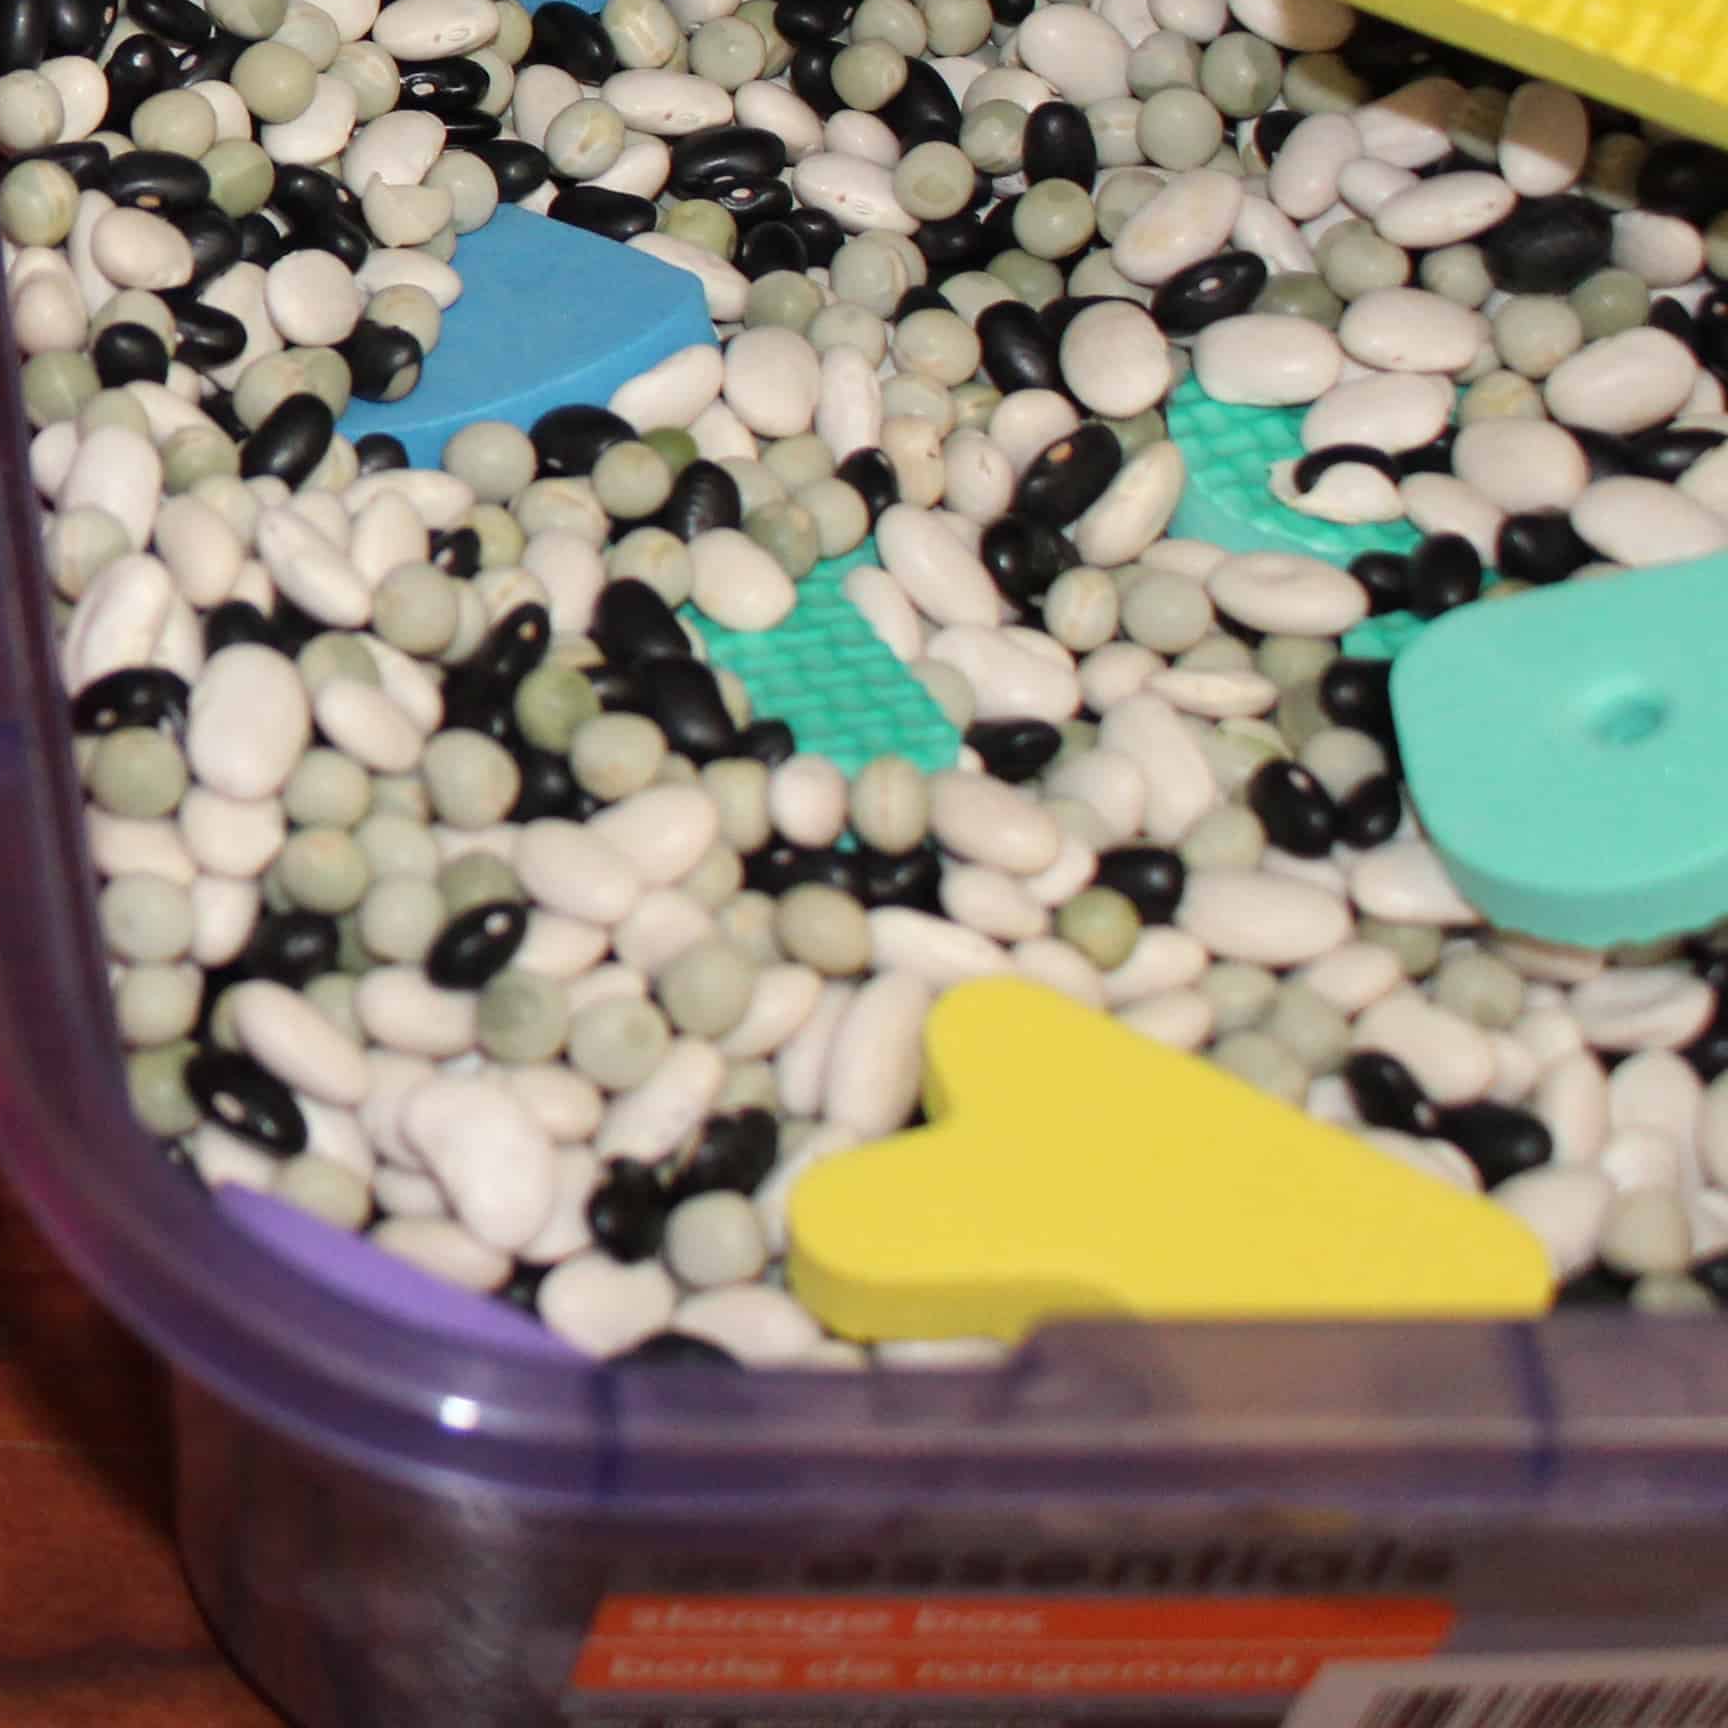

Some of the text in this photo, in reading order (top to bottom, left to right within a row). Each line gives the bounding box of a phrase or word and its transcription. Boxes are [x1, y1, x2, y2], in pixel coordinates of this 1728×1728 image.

[802, 1537, 1454, 1590] essentials
[632, 1600, 1044, 1642] storage box
